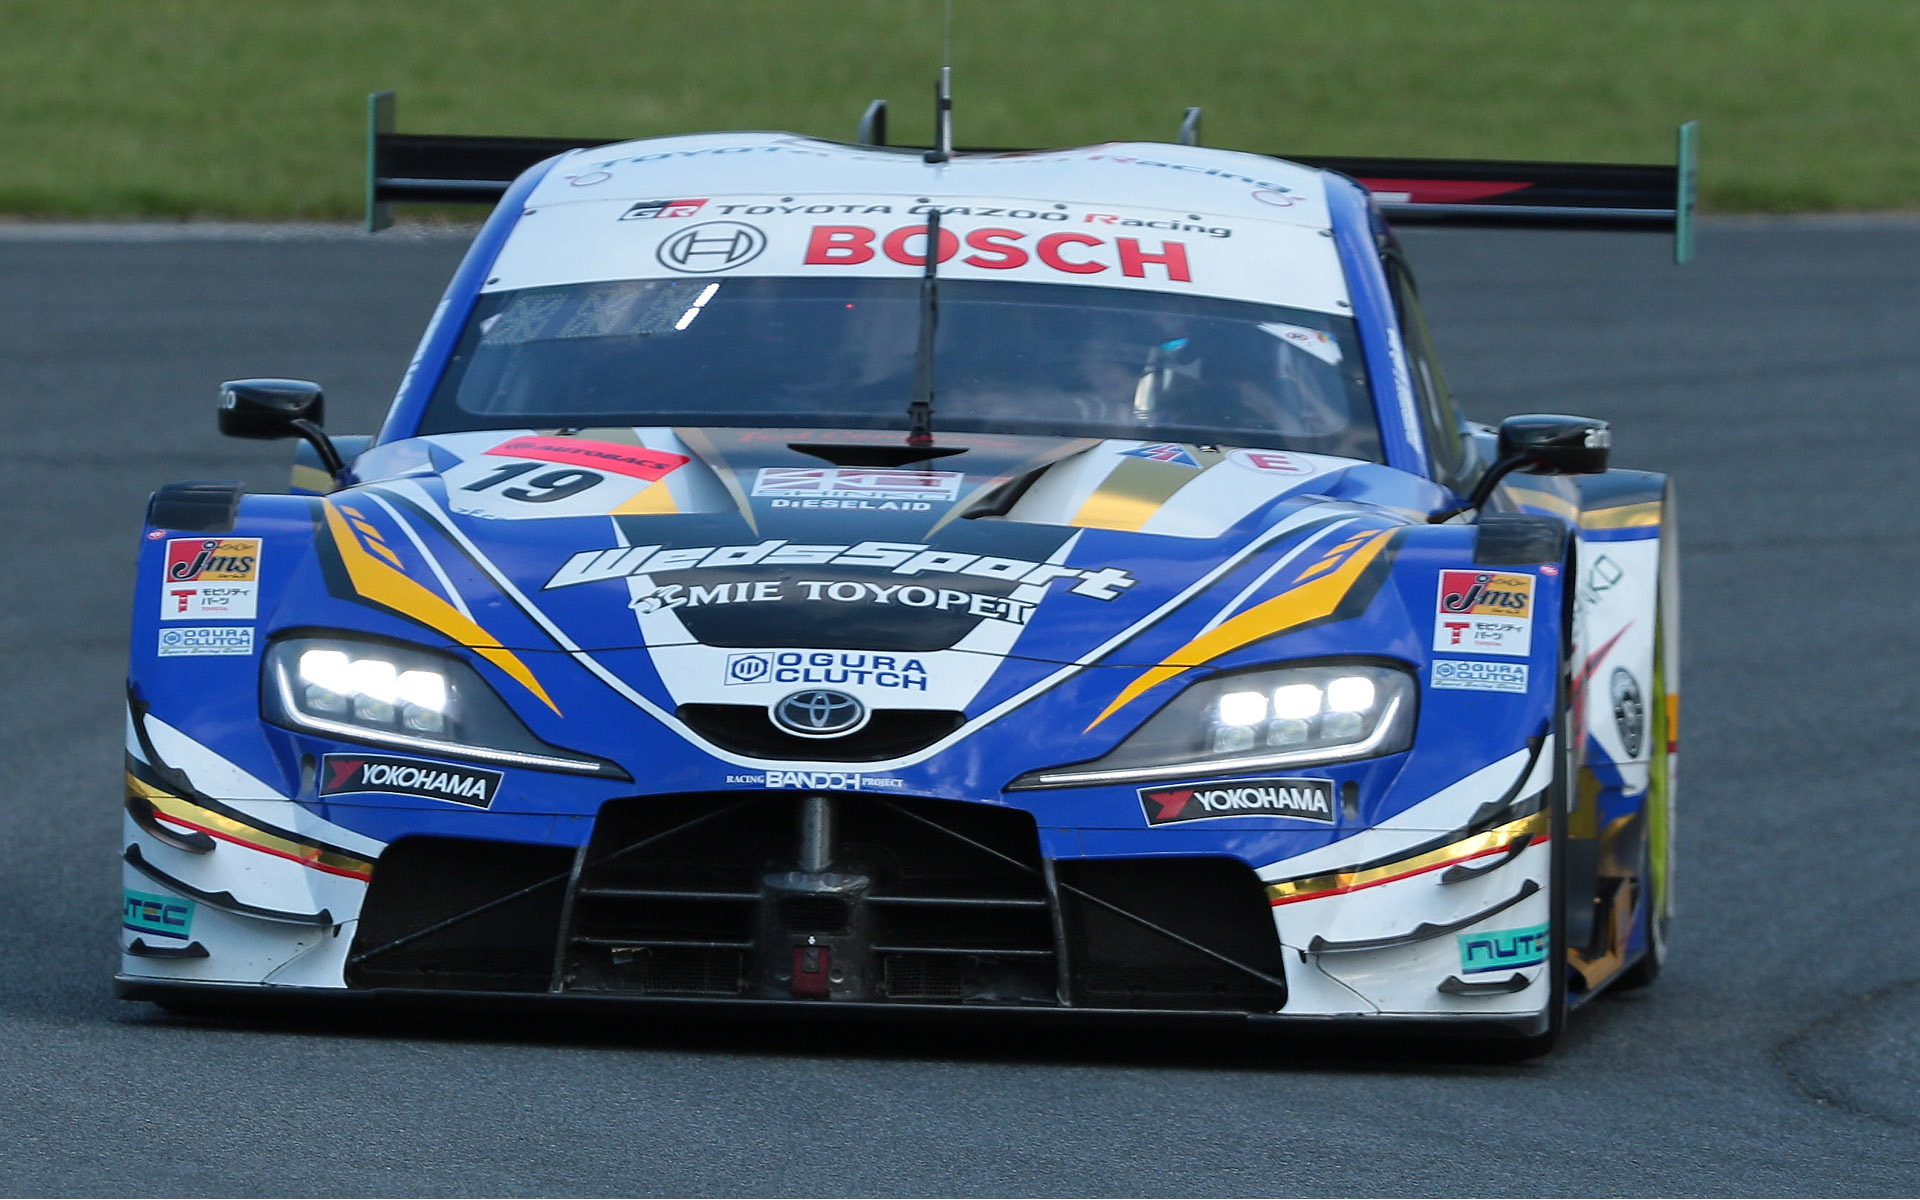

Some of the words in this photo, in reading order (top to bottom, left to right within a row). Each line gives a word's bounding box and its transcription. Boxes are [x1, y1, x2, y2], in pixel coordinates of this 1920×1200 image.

[716, 204, 893, 215] TOYOTA
[907, 204, 1069, 222] GAZOO
[1083, 212, 1233, 239] Racing
[802, 225, 1192, 283] BOSCH
[538, 444, 671, 470] AUTOBACS
[460, 461, 605, 504] 19
[541, 538, 1137, 601] WedsSport
[687, 581, 784, 607] MIE
[797, 580, 1038, 625] TOYOPET
[183, 637, 251, 646] CLUTCH
[184, 629, 251, 637] OGURA
[777, 652, 928, 675] OGURA
[774, 668, 928, 692] CLUTCH
[1456, 671, 1525, 683] CLUTCH
[361, 763, 487, 801] YOKOHAMA
[726, 774, 765, 784] RACING
[765, 771, 861, 790] BANDOH
[862, 777, 904, 787] PROJECT
[1193, 787, 1330, 813] YOKOHAMA
